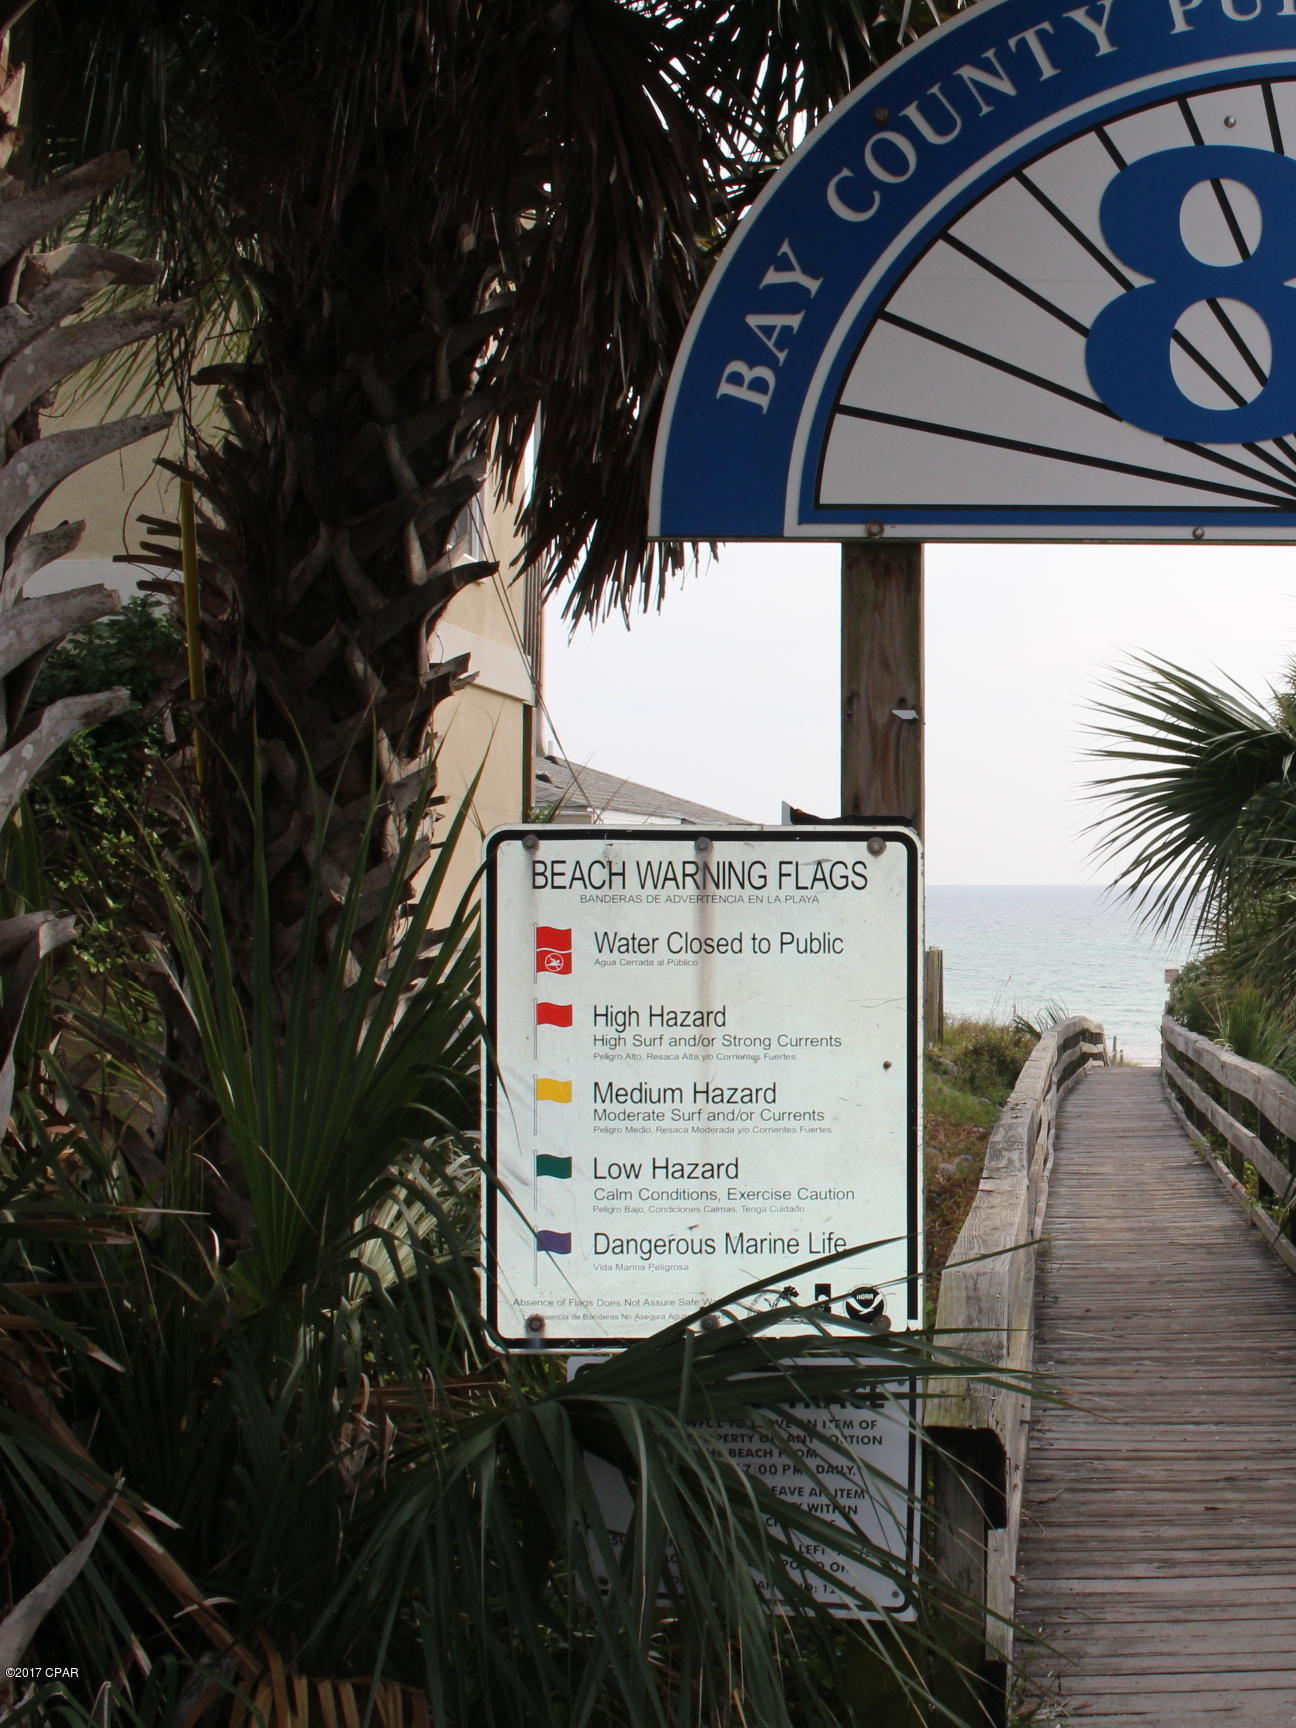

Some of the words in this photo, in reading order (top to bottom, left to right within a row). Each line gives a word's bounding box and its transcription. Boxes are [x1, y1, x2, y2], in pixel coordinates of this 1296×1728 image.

[716, 238, 824, 414] BAY
[827, 5, 1119, 222] COUNTY
[532, 860, 625, 890] BEACH
[636, 861, 767, 890] WARNING
[779, 859, 867, 890] FLAGS
[580, 895, 643, 903] BANDERAS
[646, 895, 661, 903] DE
[666, 894, 744, 904] ADVERTENCIA
[748, 895, 763, 903] EN
[767, 895, 781, 903] LA
[785, 895, 819, 903] PLAYA
[594, 932, 659, 954] Water
[667, 931, 742, 954] Closed
[751, 933, 770, 954] to
[780, 932, 843, 954] Public
[594, 1005, 639, 1033] High
[650, 1005, 725, 1027] Hazard
[594, 1034, 626, 1050] High
[633, 1034, 664, 1047] Surf
[669, 1034, 716, 1047] and/or
[722, 1034, 771, 1050] Strong
[777, 1034, 842, 1047] Currents
[594, 1082, 682, 1104] Medium
[694, 1082, 776, 1104] Hazard
[594, 1109, 665, 1121] Moderate
[671, 1109, 702, 1121] Surf
[707, 1109, 755, 1121] and/or
[760, 1109, 824, 1121] Currents
[594, 1157, 642, 1179] Low
[653, 1157, 738, 1179] Hazard
[594, 1188, 632, 1200] Calm
[639, 1188, 720, 1202] Conditions,
[728, 1188, 791, 1200] Exercise
[798, 1188, 854, 1200] Caution
[594, 1232, 715, 1261] Dangerous
[726, 1233, 799, 1254] Marine
[809, 1232, 847, 1254] Life
[513, 1298, 554, 1307] Absence
[569, 1298, 593, 1308] Flags
[597, 1299, 621, 1307] Does
[624, 1298, 640, 1306] Not
[643, 1298, 675, 1306] Assure
[679, 1298, 699, 1307] Safe
[729, 1448, 773, 1458] BEACH
